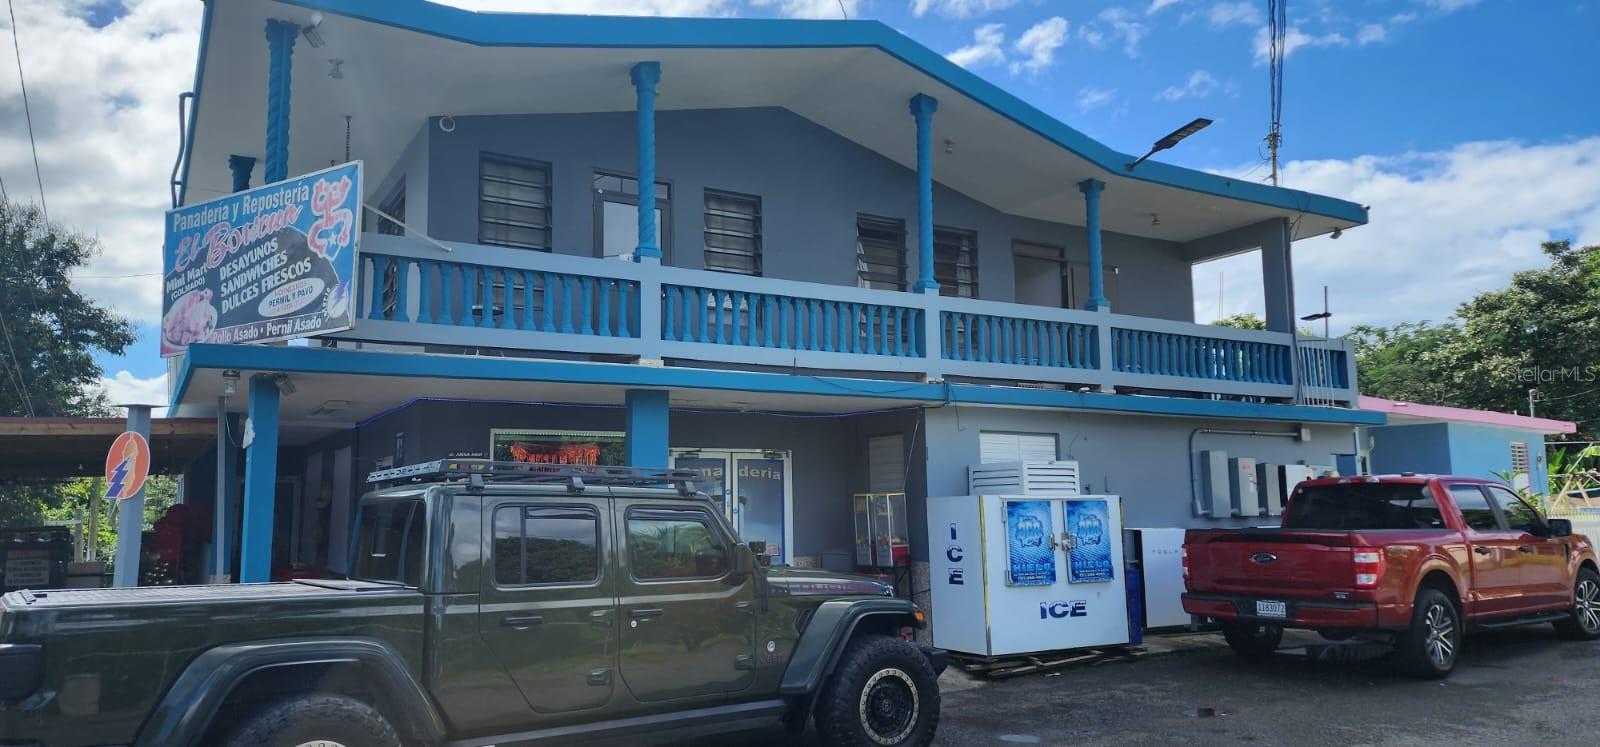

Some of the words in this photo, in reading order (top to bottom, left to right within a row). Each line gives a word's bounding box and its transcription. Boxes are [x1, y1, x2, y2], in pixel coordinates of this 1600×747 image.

[173, 202, 229, 232] Panadería
[232, 202, 240, 222] y
[242, 182, 309, 216] Repostería
[175, 232, 201, 272] El
[220, 237, 278, 280] DESAYUNOS
[166, 274, 186, 294] Mini
[187, 263, 208, 281] Mart
[172, 276, 206, 301] (COLMADO)
[220, 250, 288, 297] SANDWICHES
[222, 282, 259, 314] DULCES
[262, 257, 312, 294] FRESCOS
[269, 295, 290, 307] PERNIL
[213, 329, 231, 344] Pollo
[233, 325, 258, 341] Asado
[266, 320, 292, 336] Pernil
[295, 316, 322, 333] Asado
[1039, 599, 1087, 620] ICE
